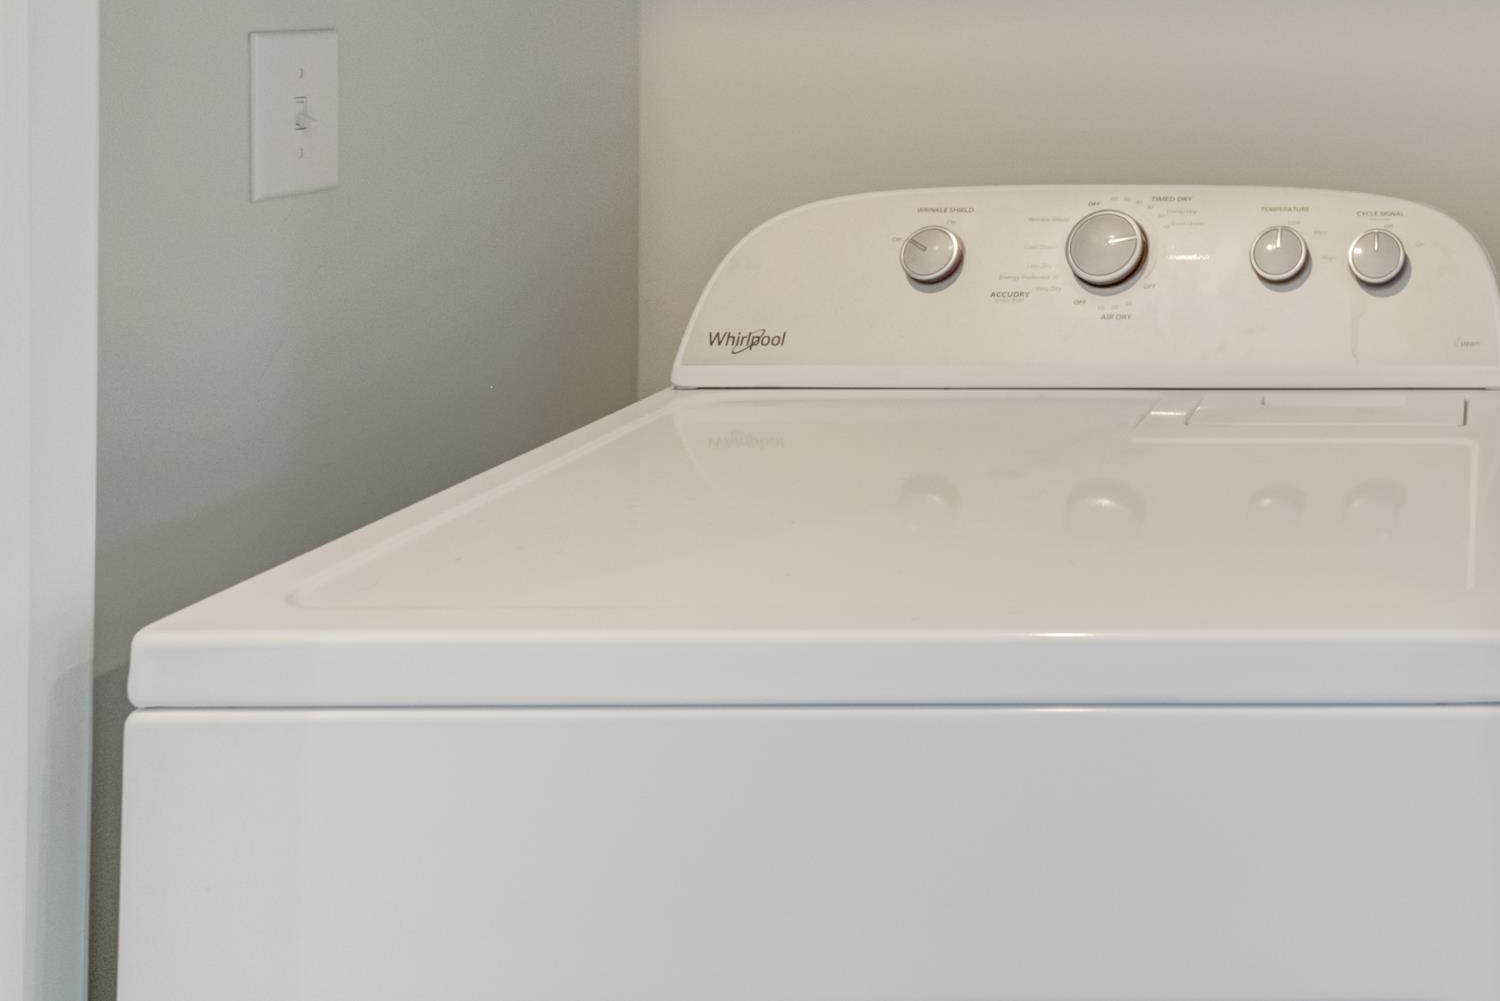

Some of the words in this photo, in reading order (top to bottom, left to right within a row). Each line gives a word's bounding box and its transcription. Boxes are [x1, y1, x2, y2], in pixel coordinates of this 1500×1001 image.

[1176, 195, 1192, 203] DRY
[949, 206, 975, 214] SHIELD
[1260, 205, 1311, 213] TEMPERATURE
[1356, 210, 1379, 218] CYCLE
[1379, 210, 1405, 218] SIGNAL
[989, 290, 1030, 299] ACCUDRY
[1114, 313, 1132, 321] DRY
[708, 328, 787, 354] Whirlpool
